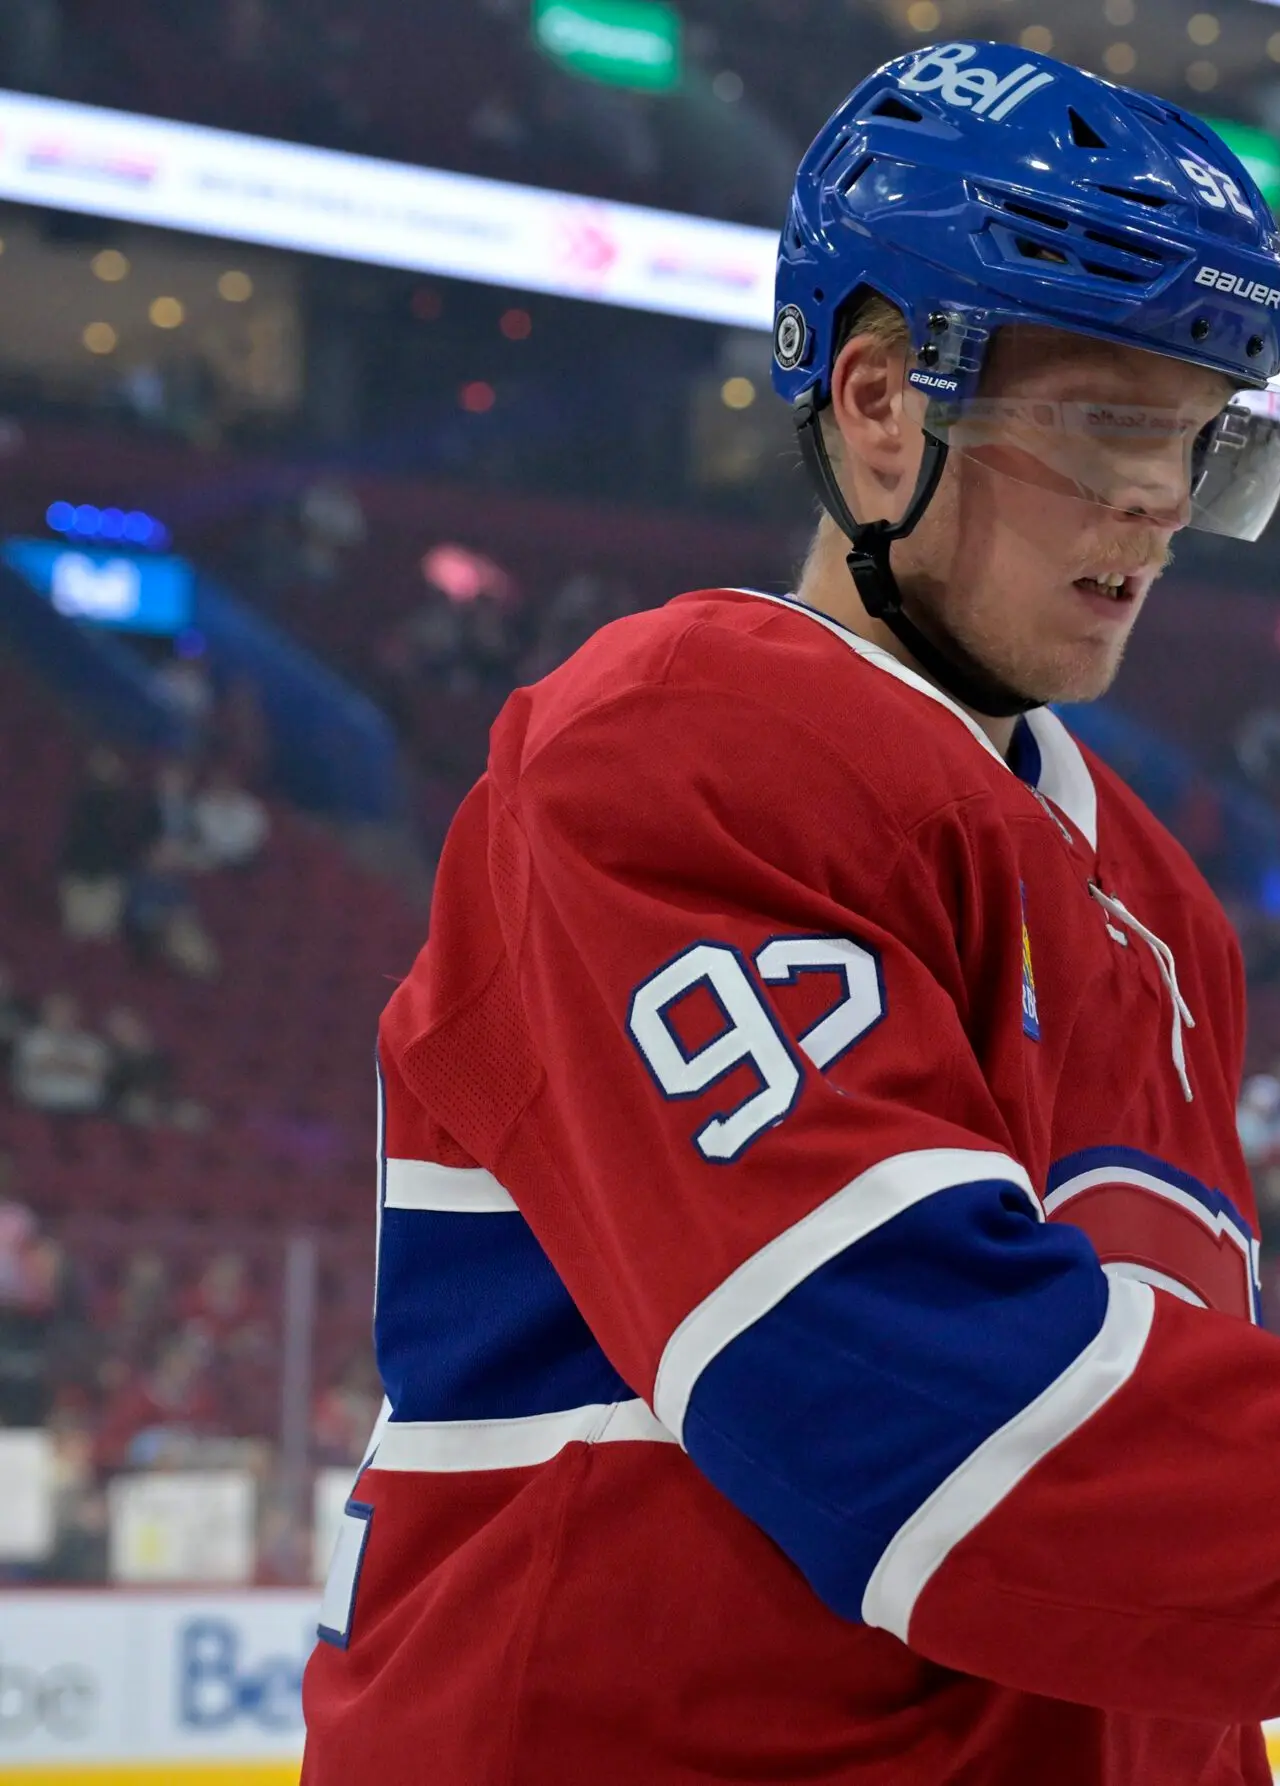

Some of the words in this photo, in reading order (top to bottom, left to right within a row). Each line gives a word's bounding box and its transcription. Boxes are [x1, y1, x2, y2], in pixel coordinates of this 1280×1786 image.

[898, 43, 1055, 122] Bell
[1178, 158, 1256, 221] 92
[624, 933, 889, 1165] 92
